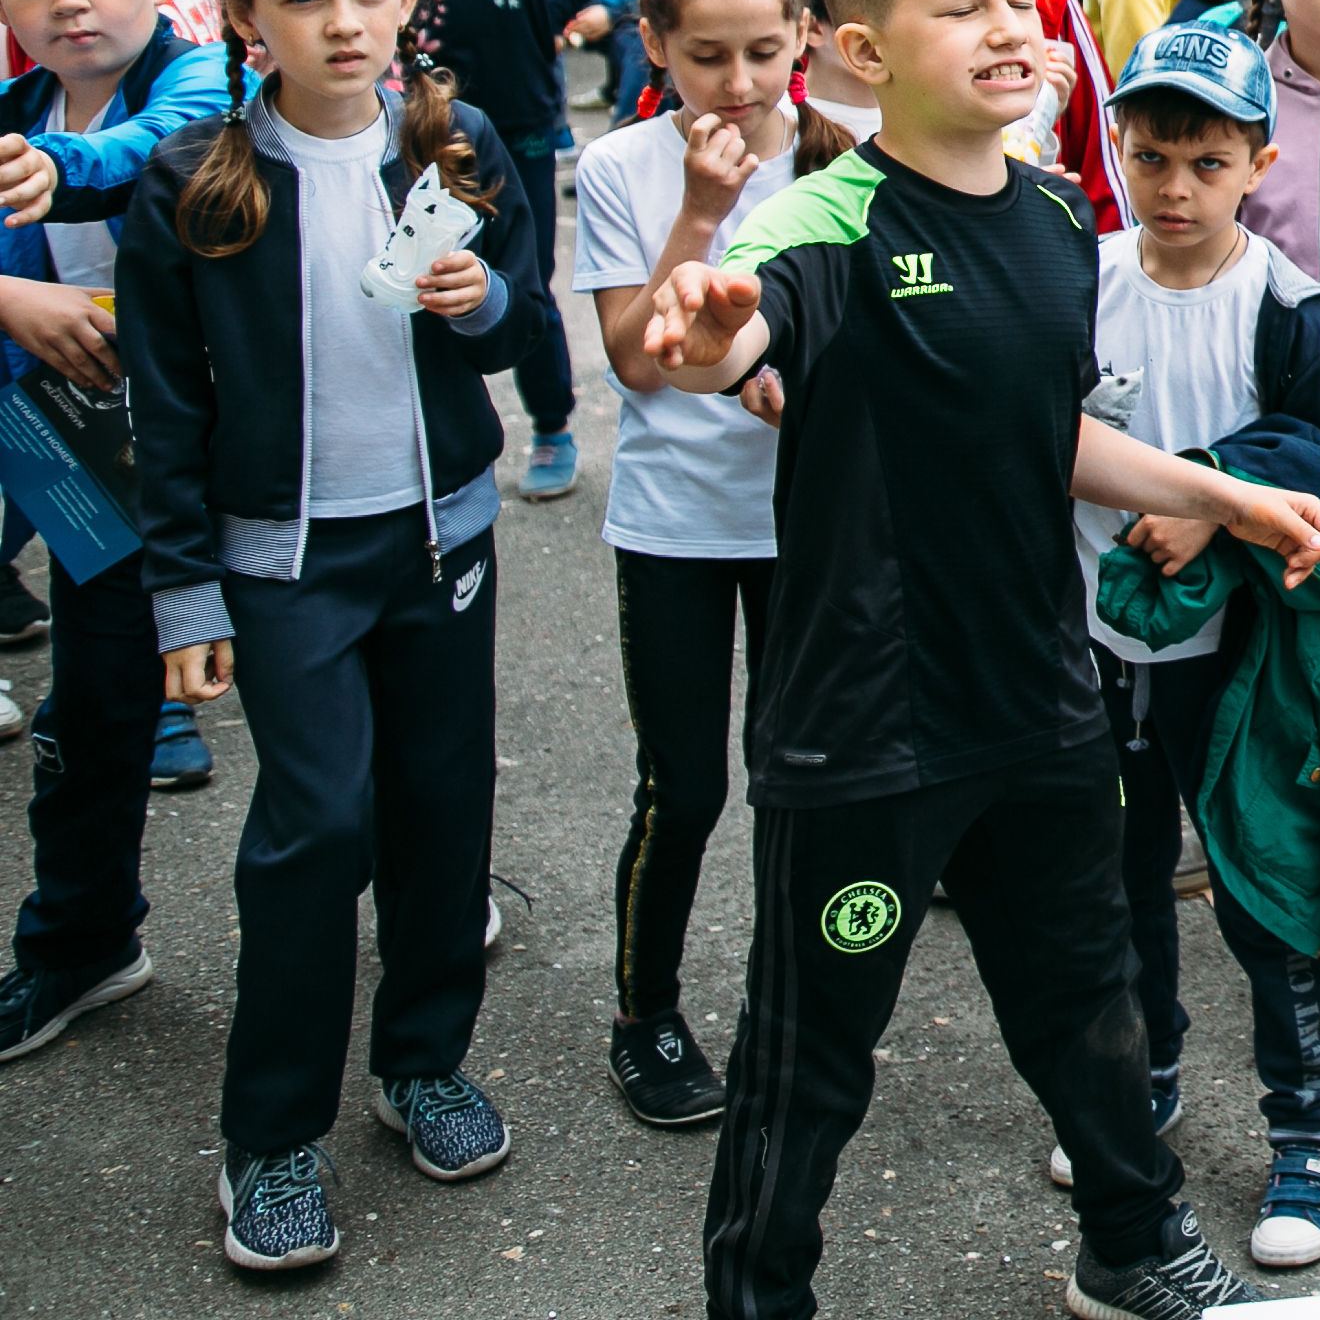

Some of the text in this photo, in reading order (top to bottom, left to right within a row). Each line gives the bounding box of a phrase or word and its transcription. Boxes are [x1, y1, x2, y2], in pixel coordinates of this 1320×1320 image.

[1154, 33, 1230, 69] VANS
[40, 380, 86, 430] ОКЕАНАРИУМ
[12, 393, 45, 431] ЧИТАЙТЕ
[39, 429, 50, 437] В
[46, 435, 79, 472] НОМЕРЕ:
[455, 560, 481, 597] NIKE
[840, 888, 888, 903] CHELSEA
